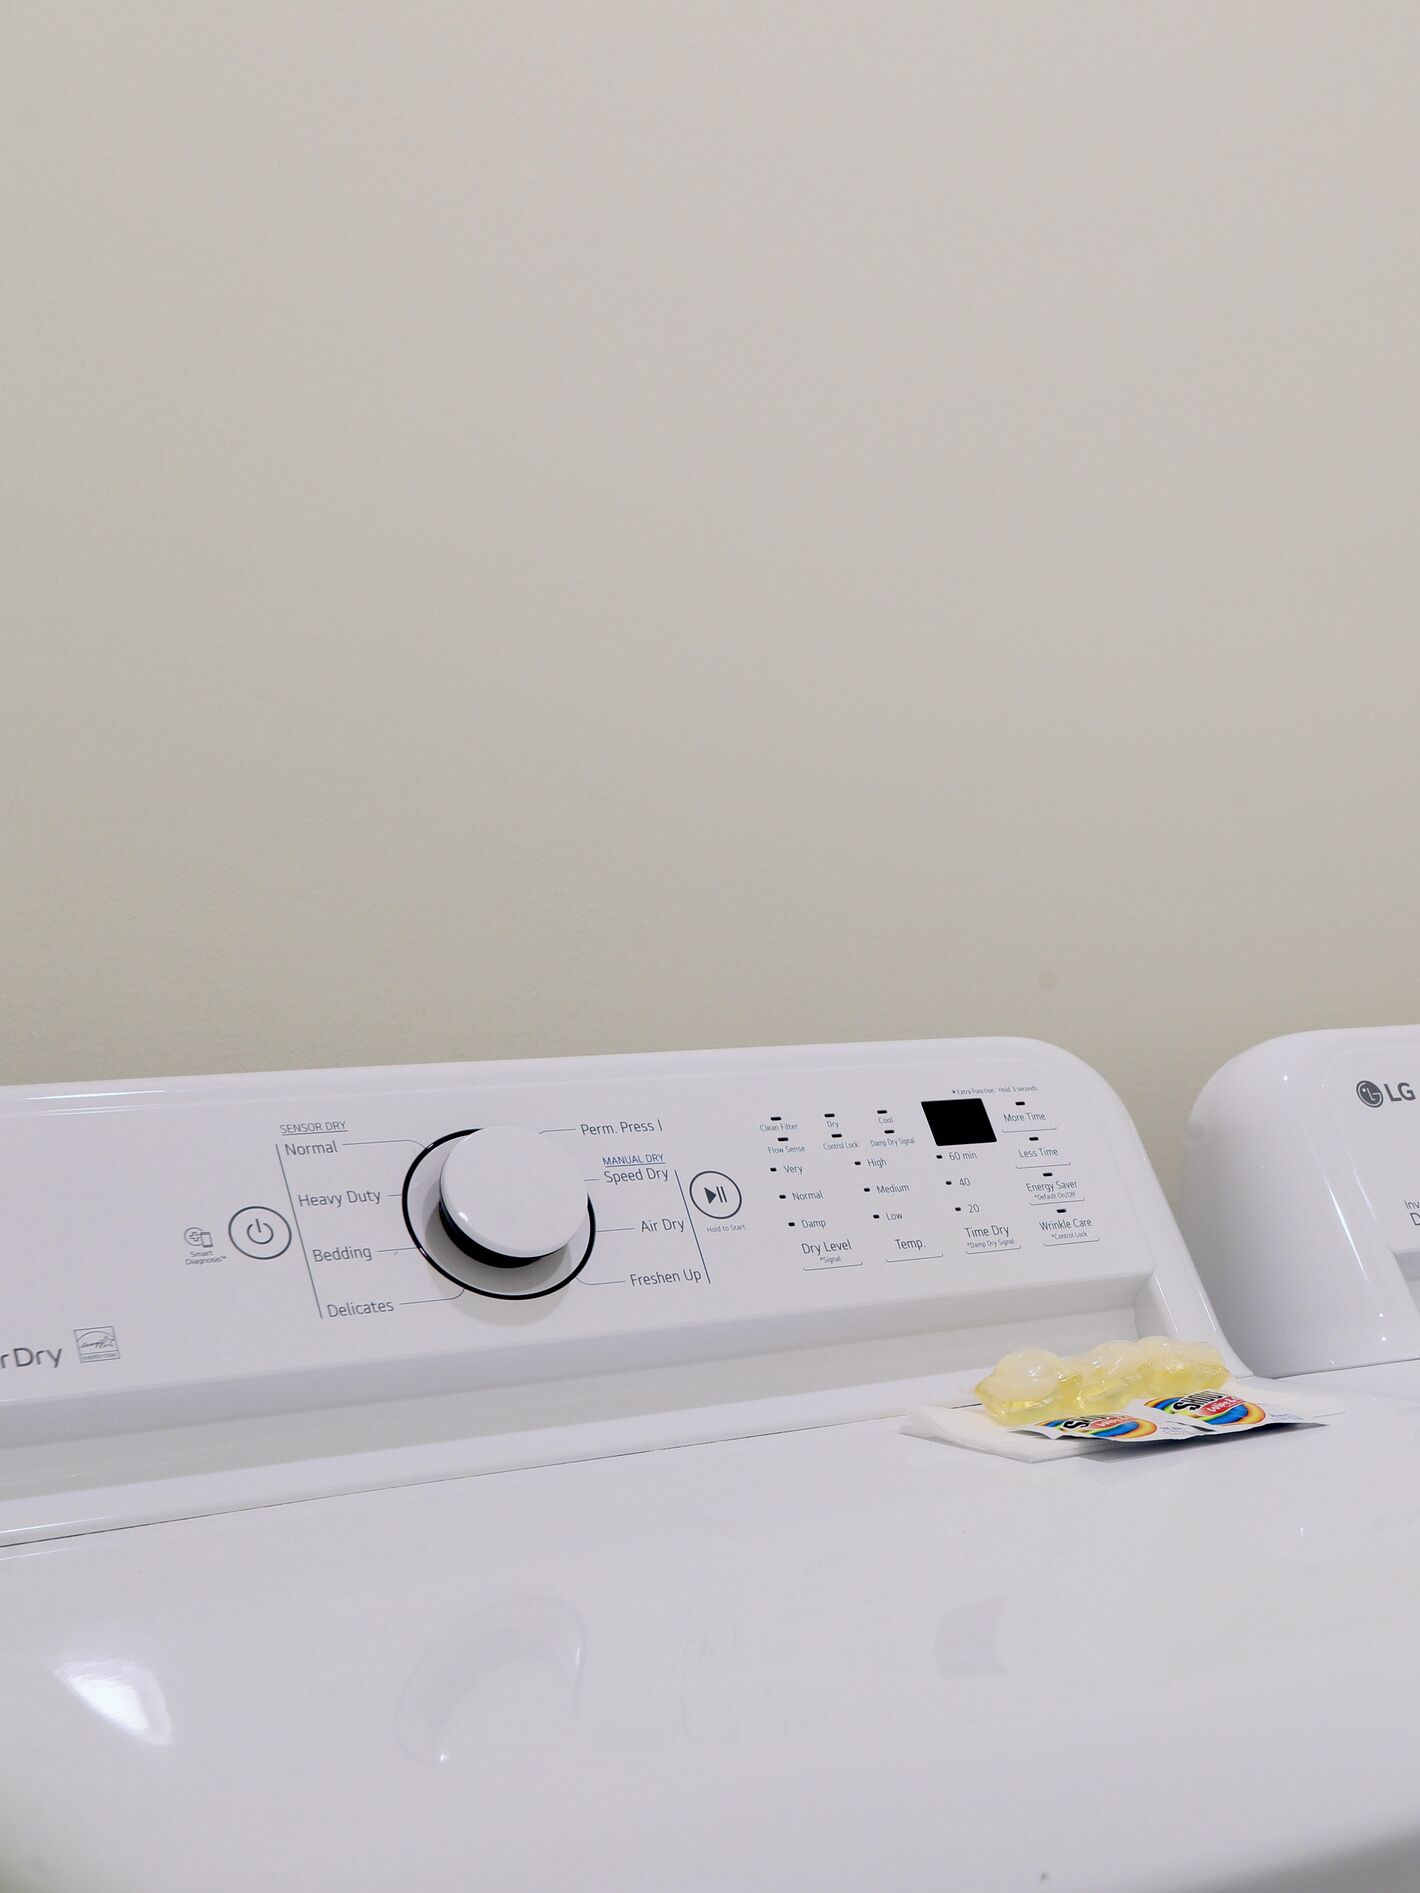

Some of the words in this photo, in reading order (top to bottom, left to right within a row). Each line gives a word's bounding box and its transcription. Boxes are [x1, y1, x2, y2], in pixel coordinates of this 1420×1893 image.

[878, 1116, 894, 1124] Cool
[1003, 1114, 1024, 1122] More
[1027, 1112, 1046, 1121] Time
[280, 1122, 321, 1134] SENSOR
[325, 1121, 347, 1131] DRY
[580, 1123, 618, 1135] Perm.
[620, 1120, 655, 1133] Press
[760, 1124, 779, 1132] Clean
[780, 1123, 798, 1131] Filter
[826, 1120, 839, 1129] Dry
[285, 1140, 338, 1155] Normal
[785, 1145, 806, 1153] Sense
[823, 1142, 845, 1151] Control
[845, 1140, 858, 1148] Lock
[948, 1151, 961, 1160] 60
[962, 1151, 977, 1160] min
[1018, 1149, 1038, 1158] Less
[1039, 1148, 1058, 1156] Time
[602, 1155, 644, 1166] MANUAL
[645, 1154, 664, 1163] DRY
[867, 1158, 887, 1168] High
[783, 1165, 803, 1174] Very
[604, 1168, 643, 1185] Speed
[646, 1167, 669, 1182] Dry
[959, 1177, 971, 1187] 40
[1026, 1182, 1054, 1193] Energy
[1055, 1180, 1078, 1190] Saver
[876, 1183, 910, 1194] Medium
[298, 1193, 342, 1207] Heavy
[346, 1190, 381, 1205] Duty
[792, 1190, 824, 1200] Normal
[968, 1203, 980, 1213] 20
[886, 1212, 903, 1221] Low
[641, 1220, 658, 1233] Air
[662, 1218, 684, 1233] Dry
[801, 1219, 827, 1229] Damp
[1039, 1220, 1072, 1231] Wrinkle
[1072, 1218, 1092, 1228] Care
[965, 1227, 990, 1238] Time
[991, 1225, 1009, 1236] Dry
[801, 1243, 821, 1256] Dry
[823, 1239, 852, 1253] Level
[894, 1238, 926, 1250] Temp.
[312, 1246, 373, 1262] Bedding
[630, 1271, 680, 1287] Freshen
[683, 1268, 701, 1284] Up
[327, 1301, 394, 1318] Delicates
